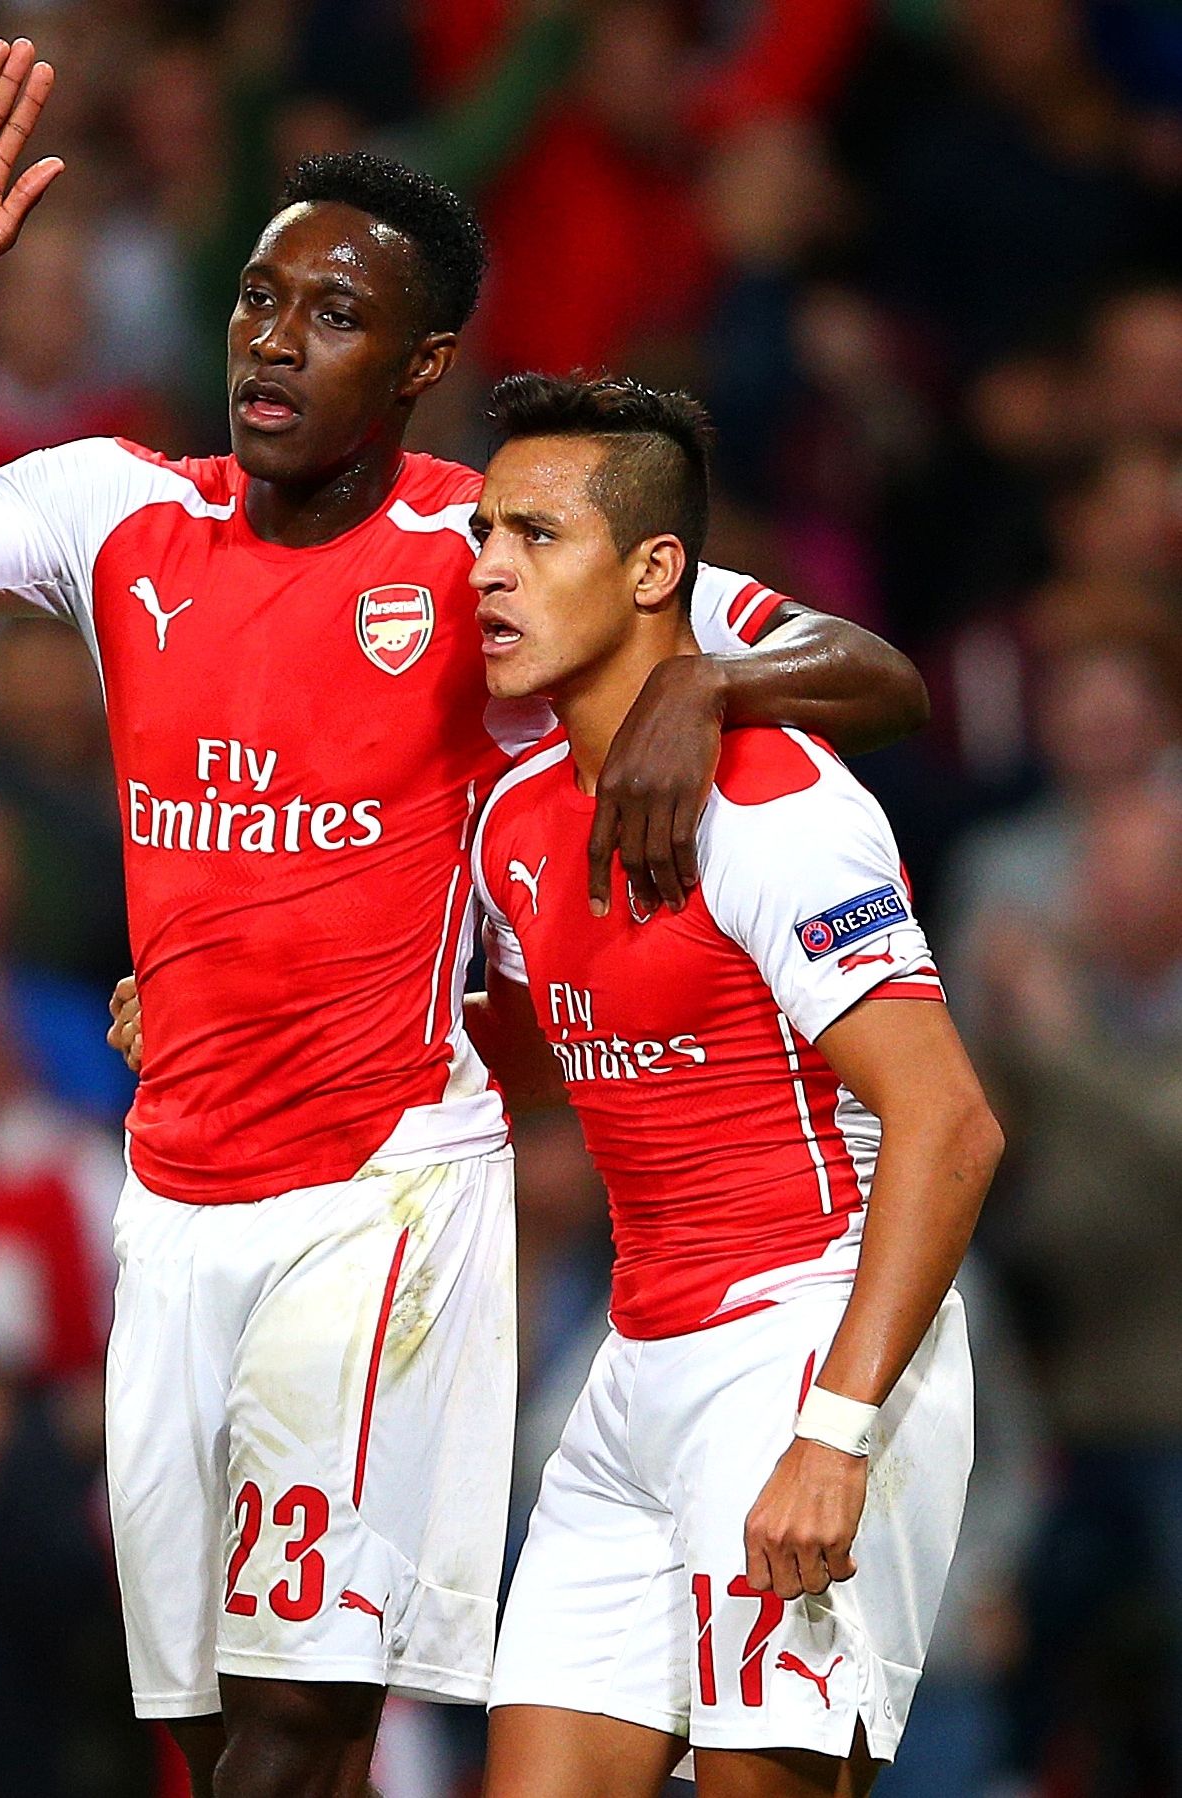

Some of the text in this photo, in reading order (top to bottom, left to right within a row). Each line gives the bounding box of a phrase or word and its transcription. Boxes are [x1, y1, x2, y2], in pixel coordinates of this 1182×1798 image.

[197, 738, 277, 792] Fly
[128, 779, 382, 852] Emirates
[832, 894, 903, 936] RESPECT
[549, 982, 593, 1031] Fly
[549, 1028, 706, 1082] mirates
[225, 1480, 330, 1622] 23
[691, 1573, 784, 1707] 17
